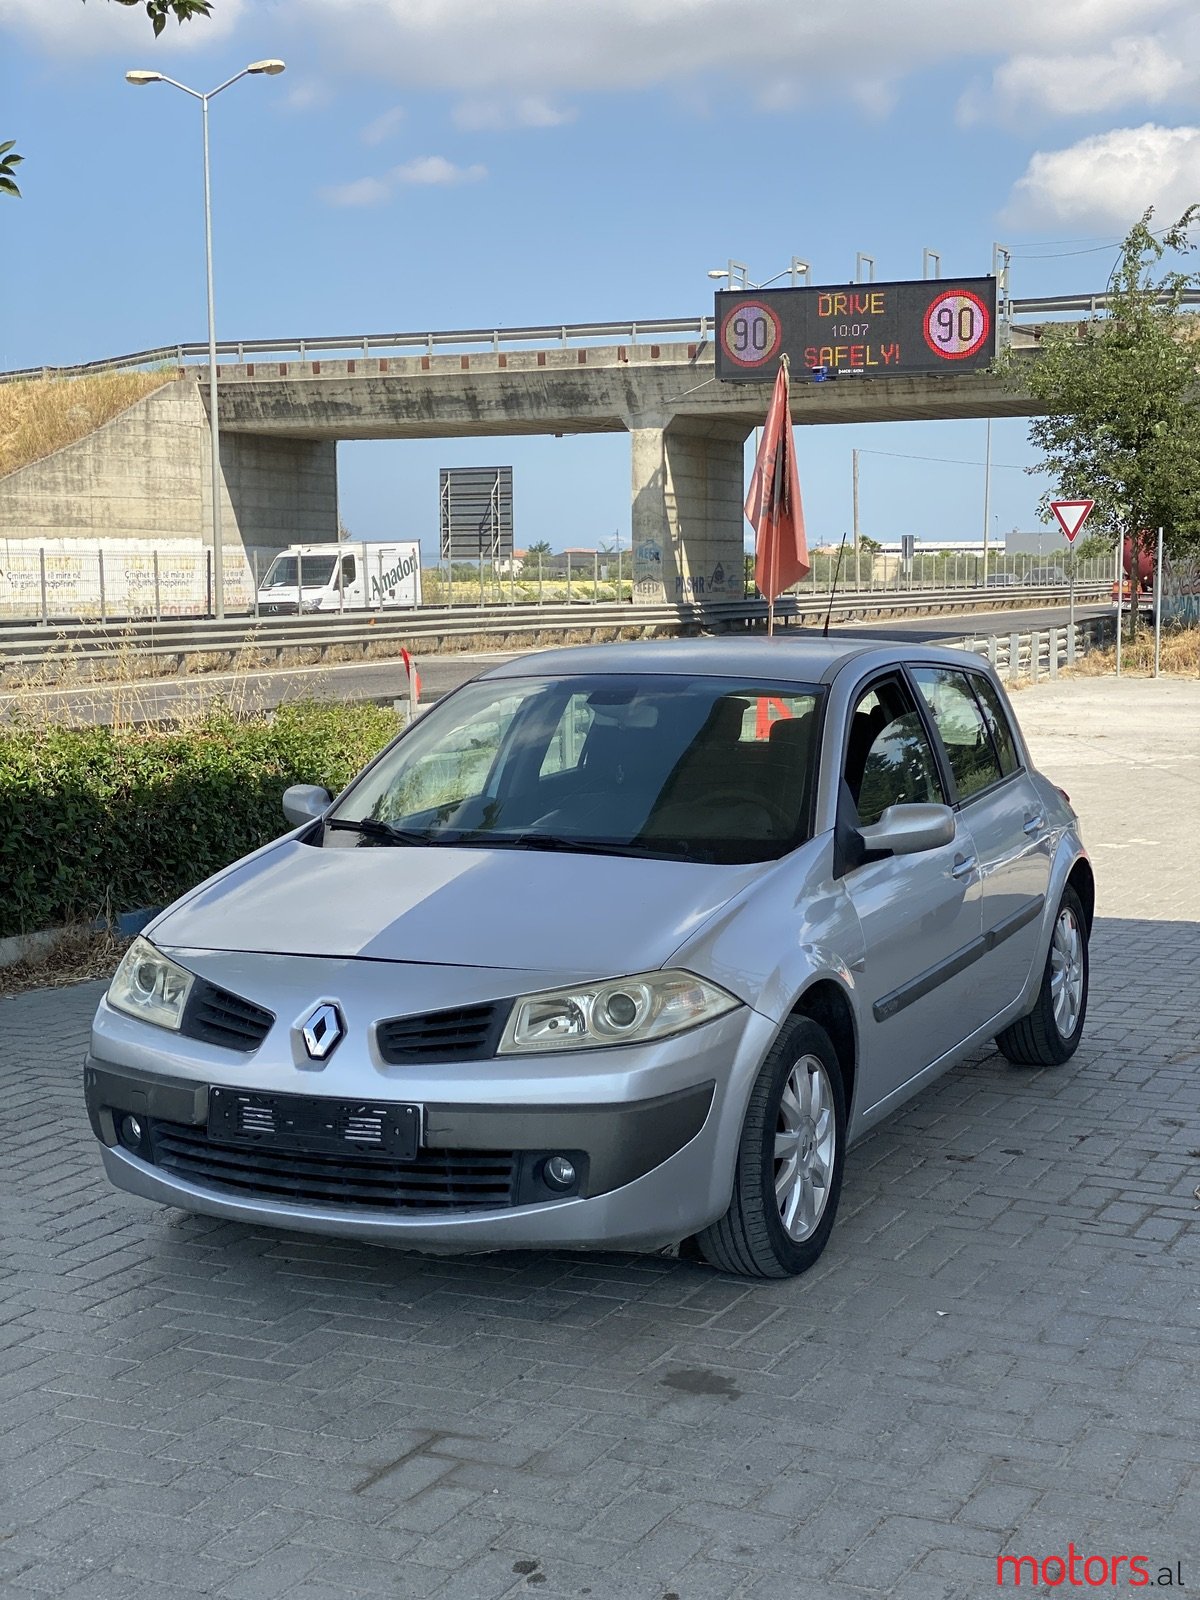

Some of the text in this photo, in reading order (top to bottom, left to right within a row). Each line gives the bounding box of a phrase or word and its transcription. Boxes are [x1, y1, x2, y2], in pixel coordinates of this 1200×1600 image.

[818, 292, 885, 317] DRIVE
[733, 317, 768, 351] 90
[831, 324, 869, 337] 10:07
[936, 307, 974, 342] 90
[804, 343, 900, 368] SAFELY!
